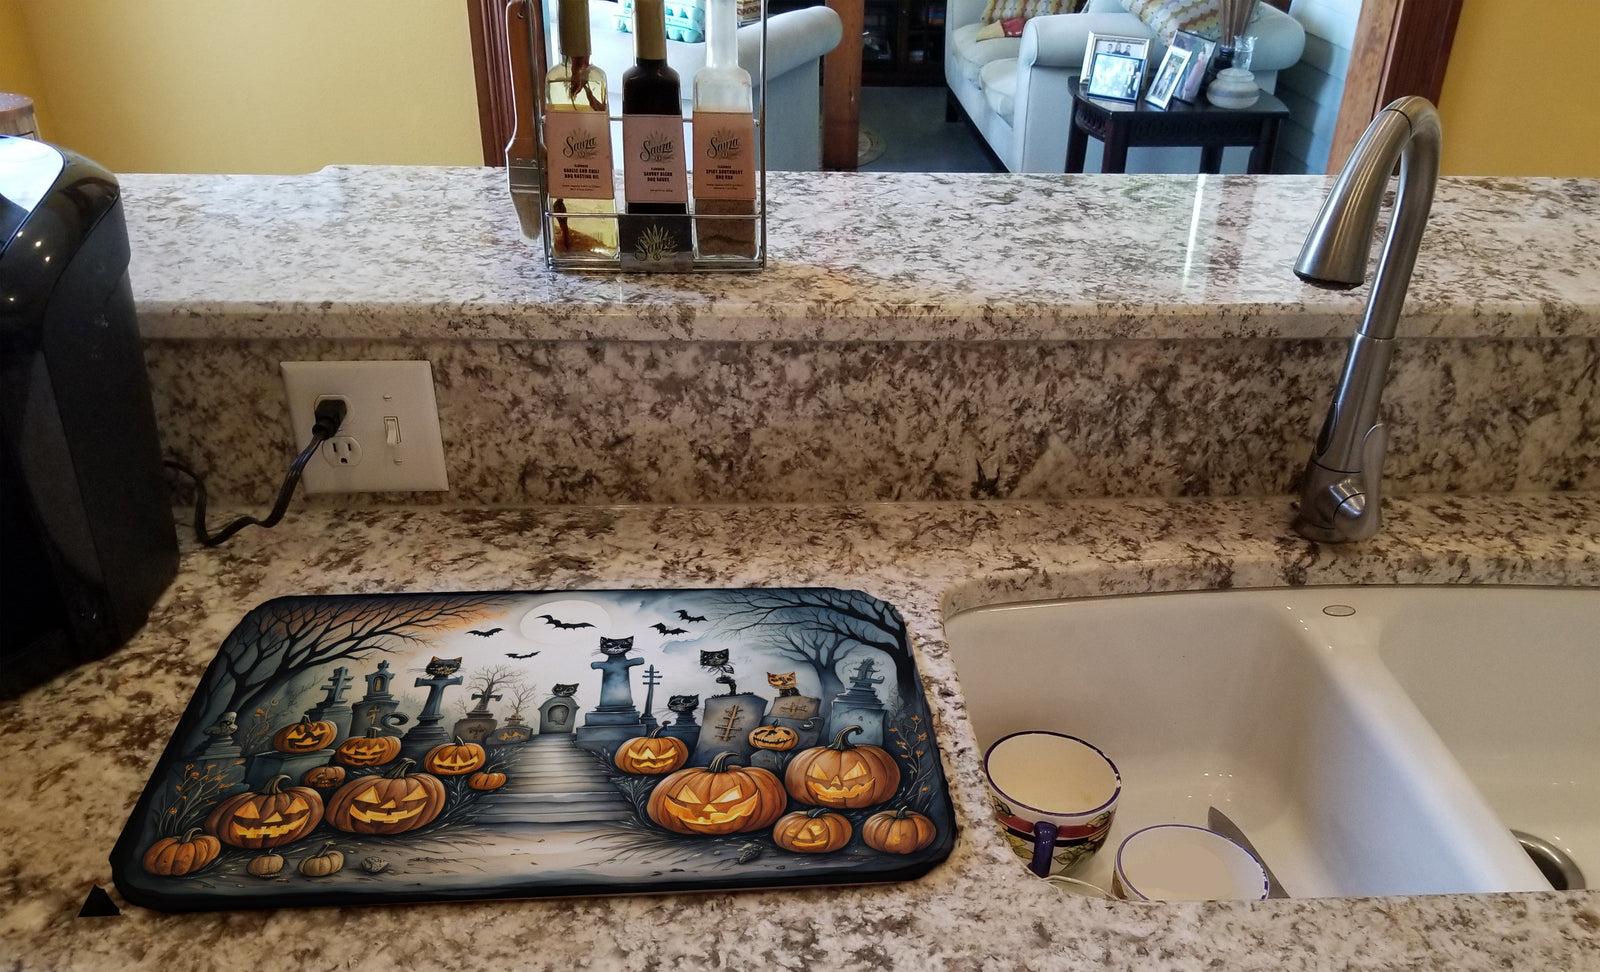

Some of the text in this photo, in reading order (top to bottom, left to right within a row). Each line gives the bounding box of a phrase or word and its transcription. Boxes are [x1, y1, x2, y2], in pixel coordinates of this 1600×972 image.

[562, 136, 597, 158] Sauza
[640, 140, 674, 161] Sauza
[707, 137, 740, 158] Sauza
